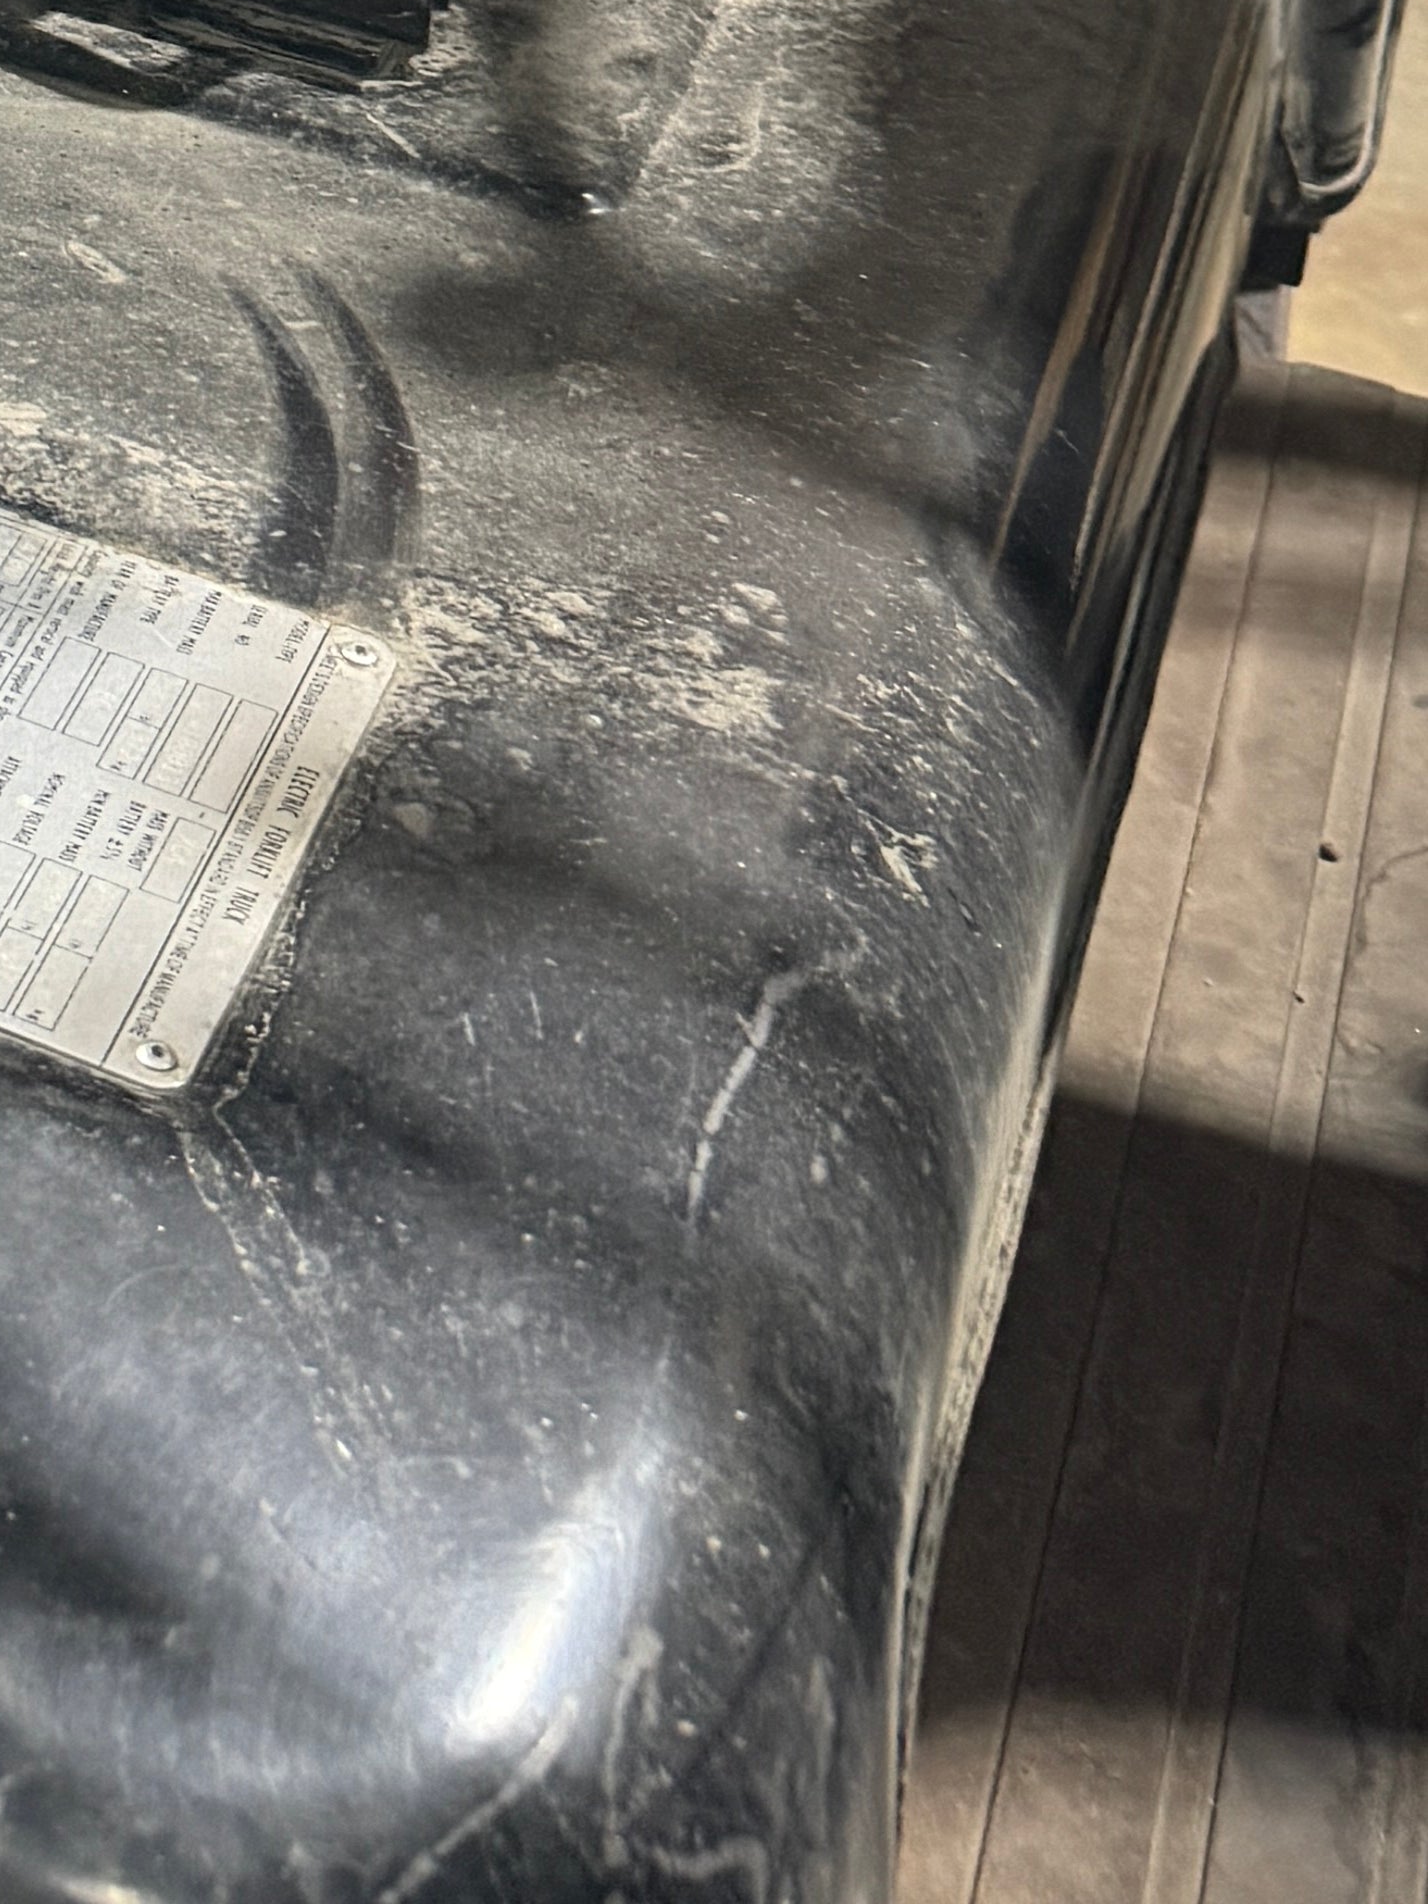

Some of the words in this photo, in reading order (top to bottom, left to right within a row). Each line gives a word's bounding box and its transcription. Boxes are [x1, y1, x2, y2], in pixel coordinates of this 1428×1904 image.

[274, 764, 321, 820] ELECTRIC
[111, 798, 148, 838] BATTERY
[143, 807, 171, 833] MASS
[55, 838, 84, 865] MASS
[122, 829, 160, 873] WITHOUT
[243, 822, 292, 881] FORKLIFT
[219, 883, 261, 927] TRUCK
